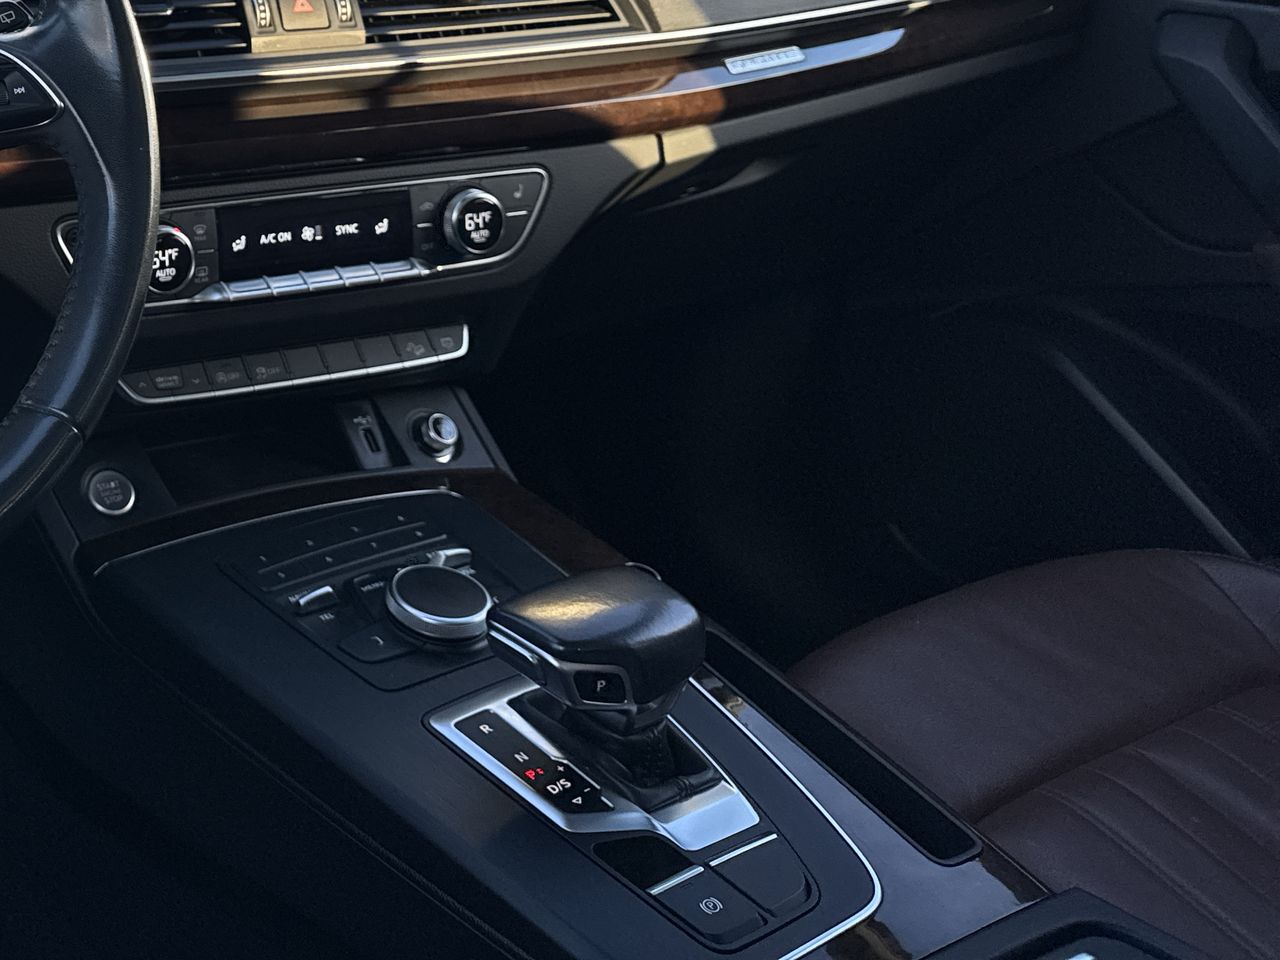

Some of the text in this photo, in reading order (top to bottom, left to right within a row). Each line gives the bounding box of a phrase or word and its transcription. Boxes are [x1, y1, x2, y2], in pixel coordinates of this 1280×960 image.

[334, 222, 360, 236] SYNC
[259, 231, 293, 246] A/C ON
[155, 267, 177, 278] AUTO
[596, 679, 606, 693] P
[478, 723, 494, 735] R
[513, 751, 530, 763] N
[545, 777, 572, 795] D/S
